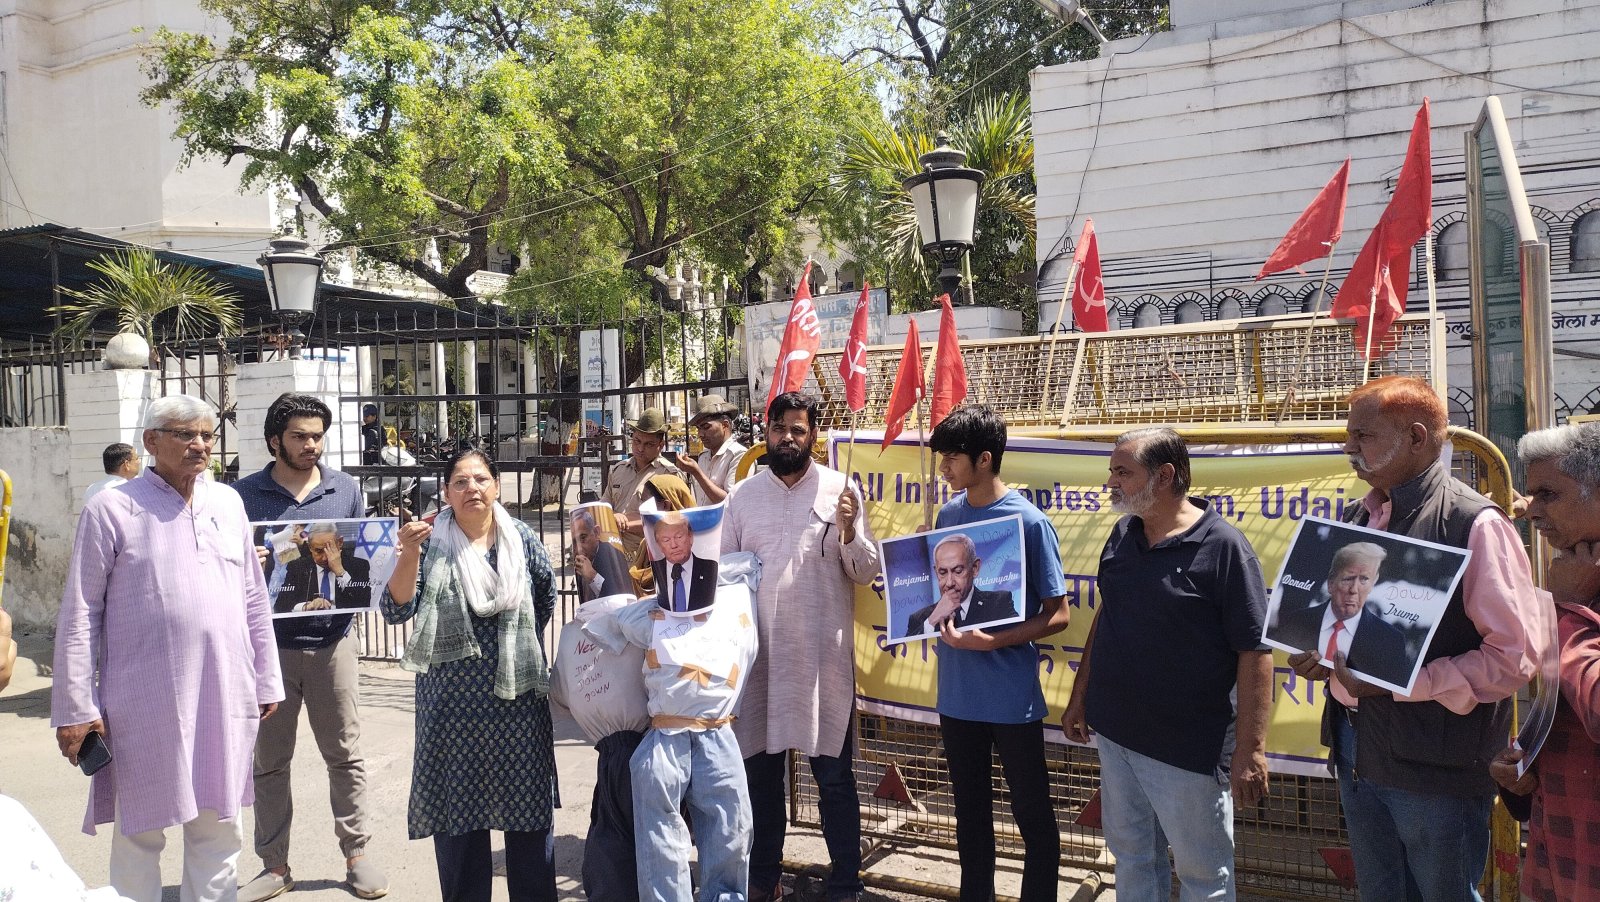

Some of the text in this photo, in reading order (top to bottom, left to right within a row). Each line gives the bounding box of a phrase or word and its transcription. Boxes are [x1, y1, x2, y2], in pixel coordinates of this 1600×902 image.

[852, 472, 883, 502] All
[895, 473, 966, 505] Indi
[1018, 482, 1108, 512] oples'
[1261, 486, 1356, 523] Udai
[893, 572, 930, 587] Benjamin
[974, 572, 1019, 586] Netanyahu
[1281, 574, 1315, 591] Donald
[1384, 603, 1420, 623] Trump
